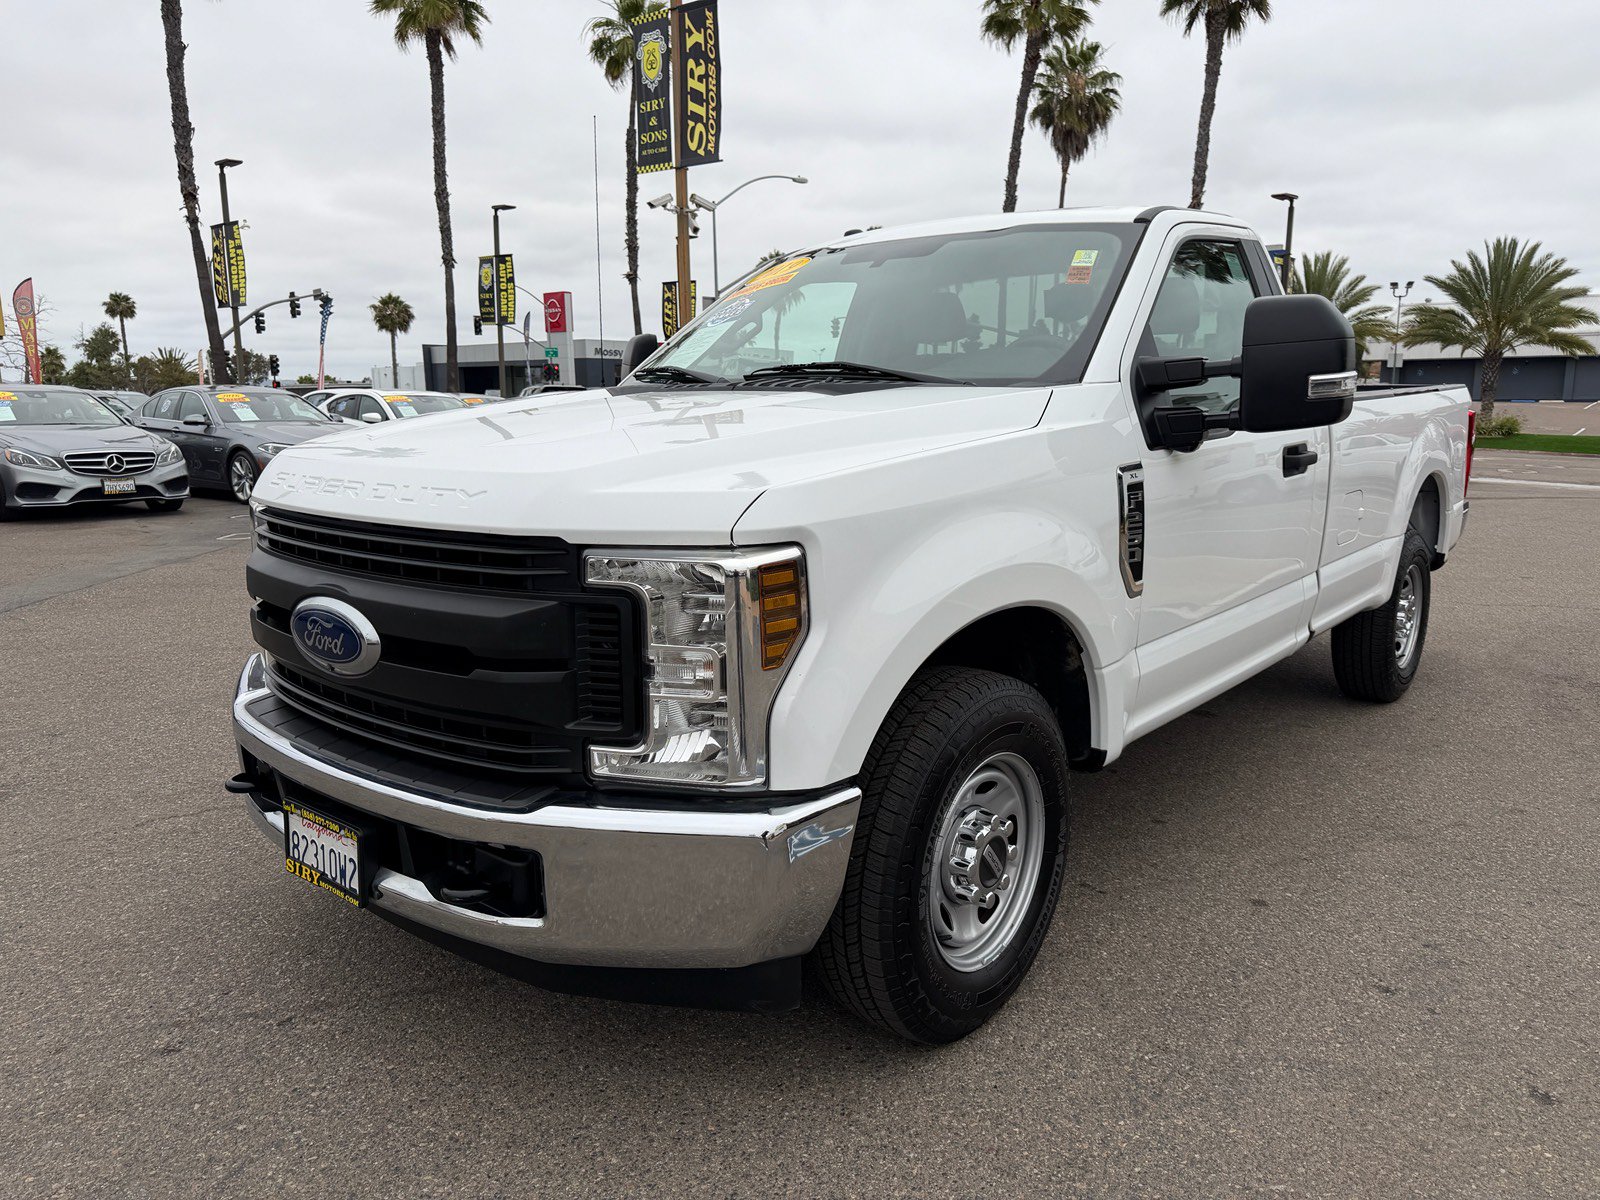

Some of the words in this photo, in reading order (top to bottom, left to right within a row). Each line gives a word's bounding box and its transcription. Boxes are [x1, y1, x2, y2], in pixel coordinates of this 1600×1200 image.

[685, 12, 706, 157] SIRY
[705, 8, 717, 155] MOTORS.COM
[639, 97, 665, 113] SIRY
[649, 116, 659, 127] &
[640, 129, 668, 145] SONS
[641, 148, 655, 156] AUTO
[232, 224, 241, 247] WE
[212, 228, 222, 301] SIRY
[229, 240, 239, 291] ANYONE
[236, 249, 245, 304] FINANCE
[499, 263, 507, 290] AUTO
[505, 256, 513, 279] FULL
[664, 284, 673, 336] SIRY
[594, 347, 624, 358] Mossy
[269, 471, 365, 499] SUPER
[367, 482, 488, 509] DUTY
[304, 616, 344, 655] Ford
[292, 830, 358, 894] 82310W2
[286, 858, 320, 885] SIRY
[320, 880, 359, 907] MOTORS.COM
